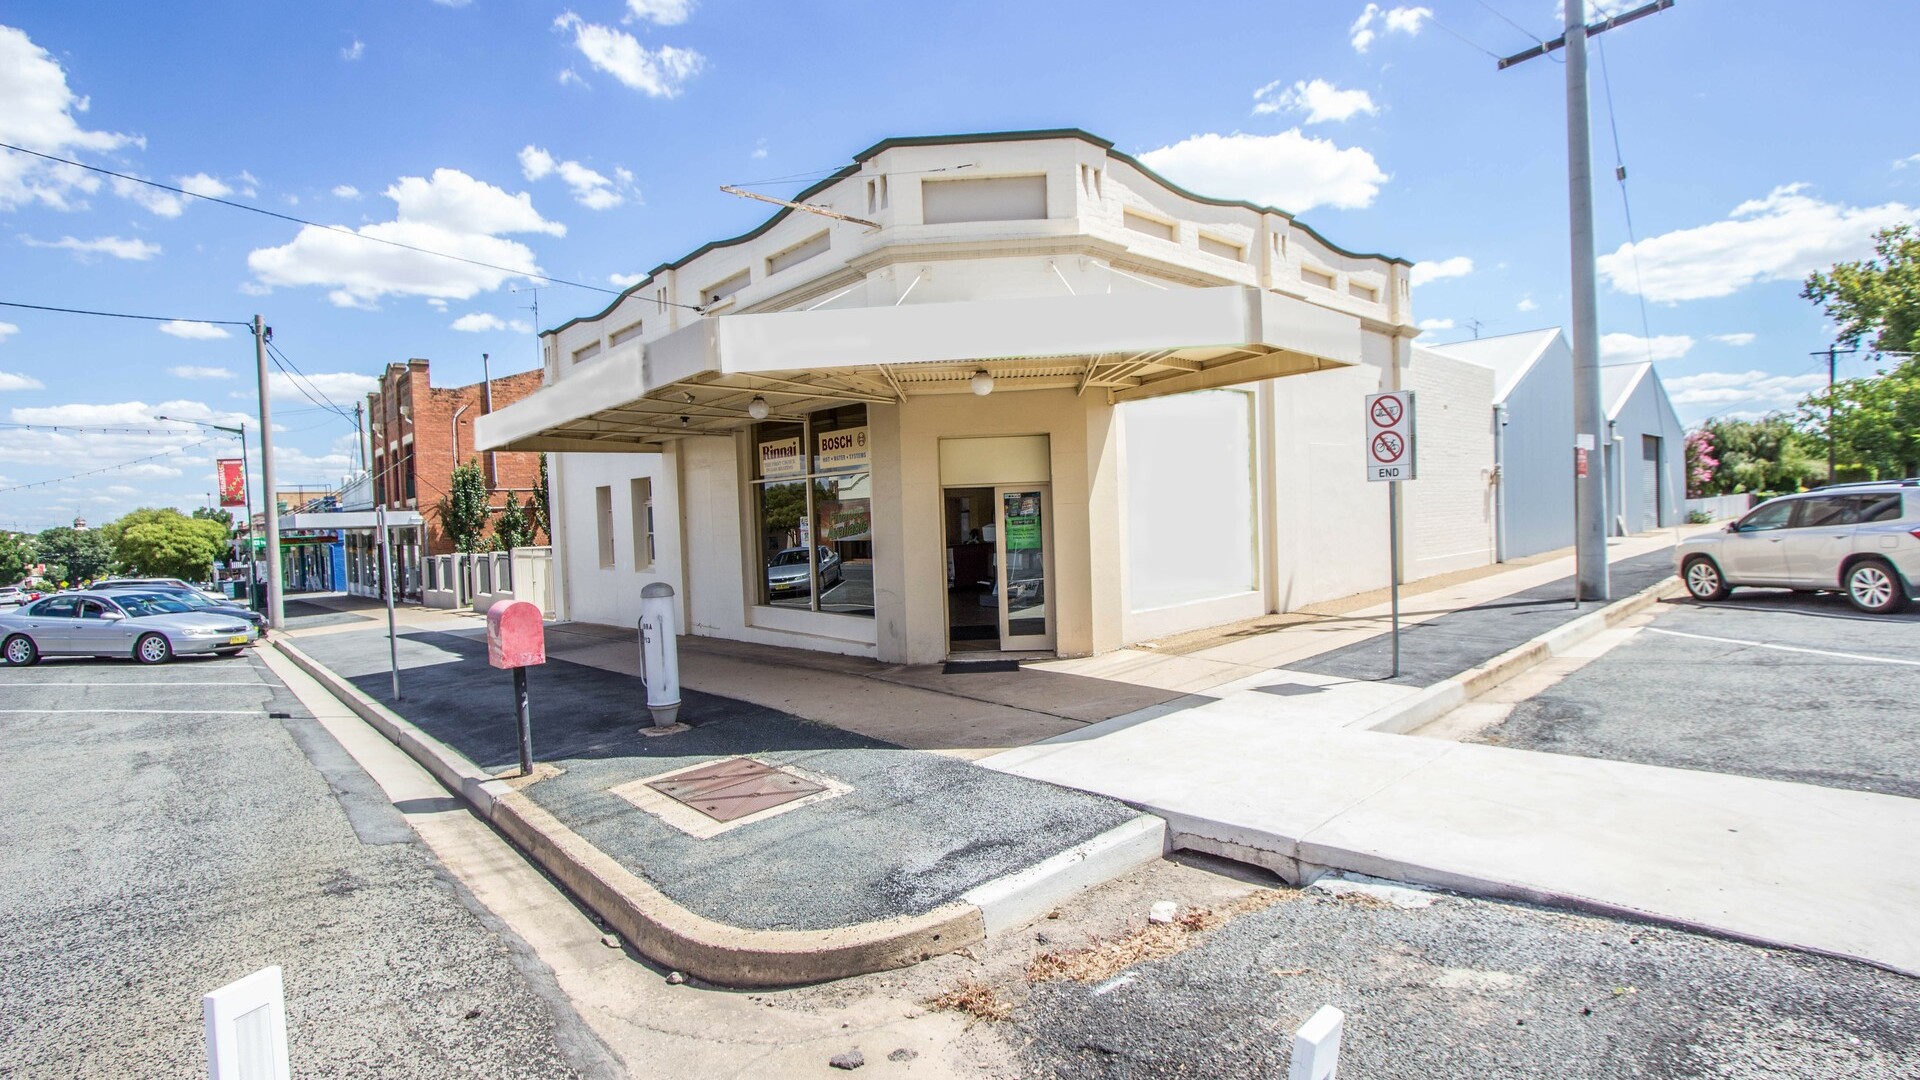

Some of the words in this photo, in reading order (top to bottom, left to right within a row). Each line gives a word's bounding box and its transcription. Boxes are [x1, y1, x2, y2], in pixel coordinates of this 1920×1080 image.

[762, 441, 797, 460] Rinnai
[822, 435, 852, 451] BOSCH
[1379, 468, 1399, 477] END
[829, 506, 865, 525] Finance
[828, 520, 868, 539] Available
